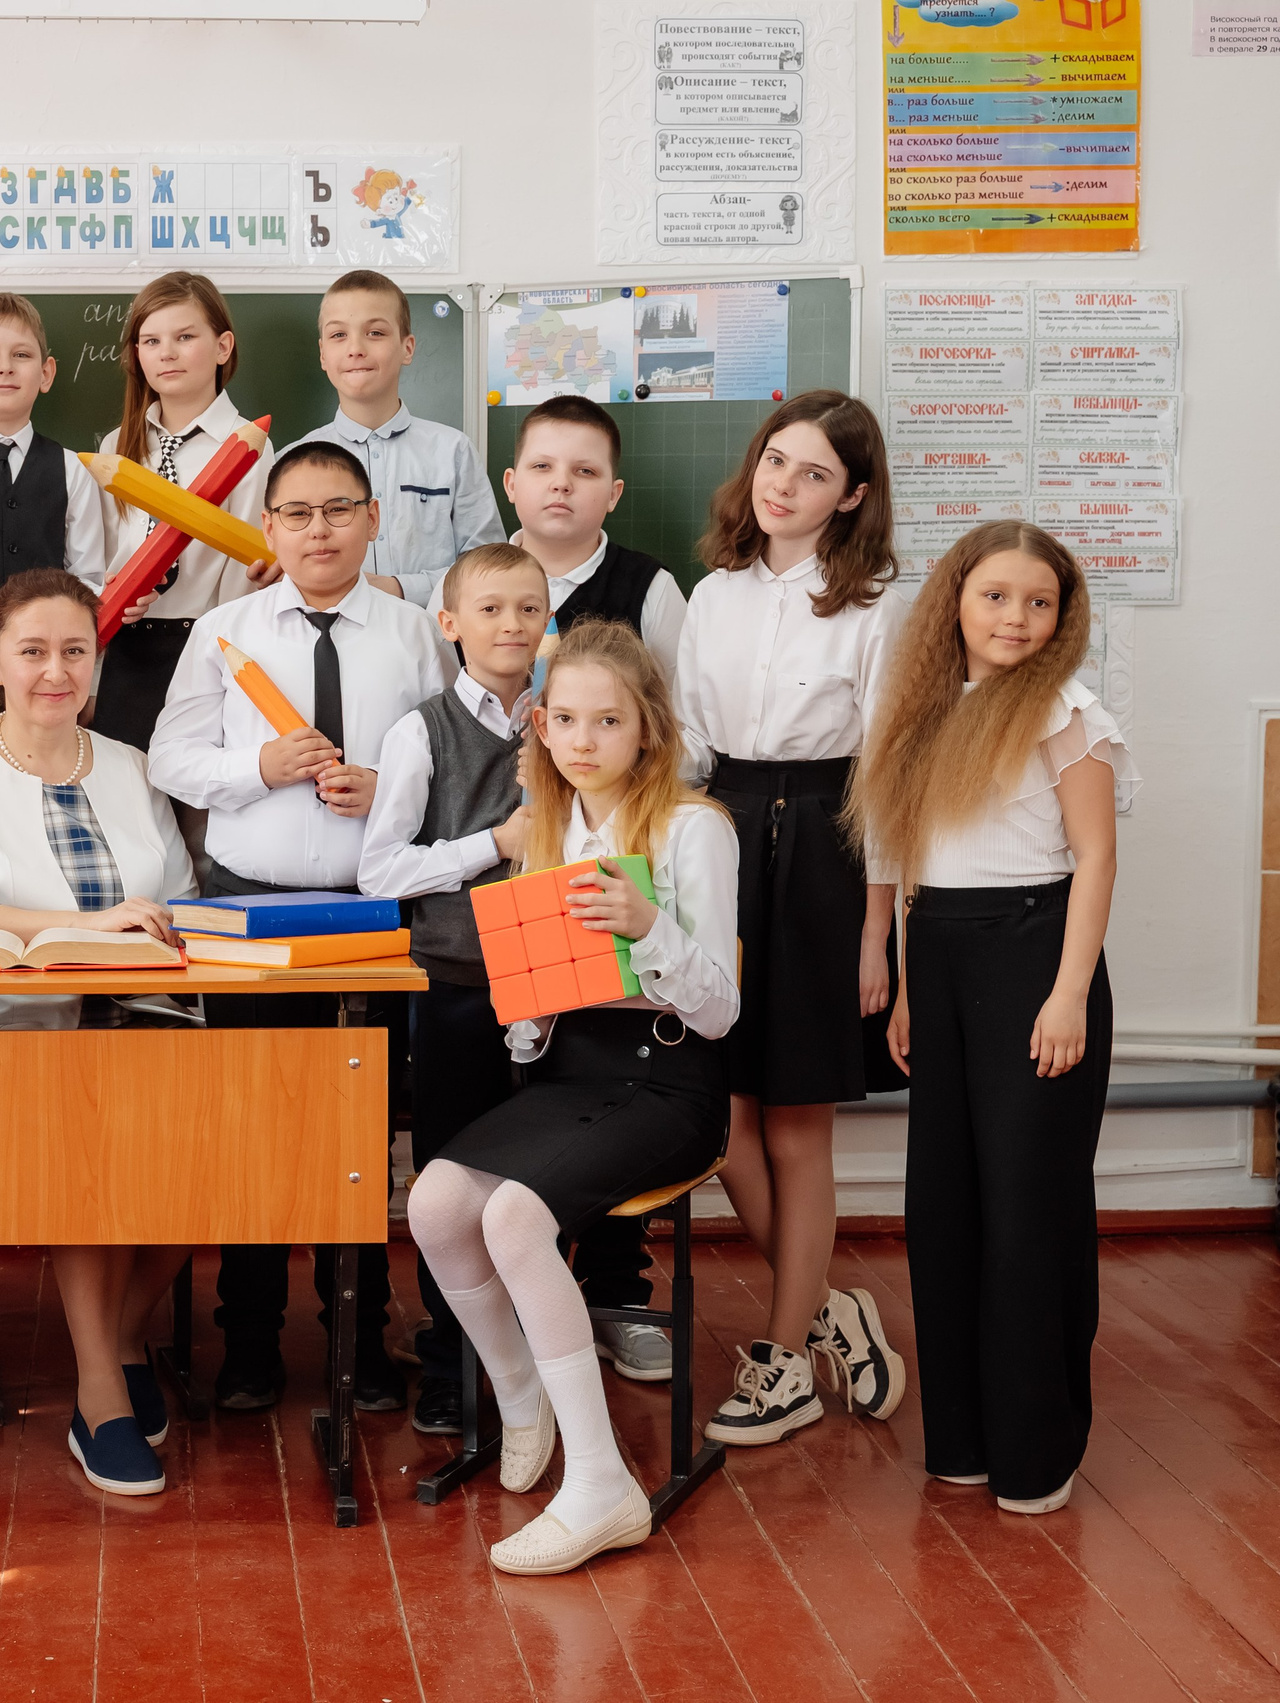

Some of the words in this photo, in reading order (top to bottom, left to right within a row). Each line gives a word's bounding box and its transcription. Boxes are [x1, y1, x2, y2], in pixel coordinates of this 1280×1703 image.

[1210, 15, 1261, 23] Високосный
[659, 23, 752, 35] Повествование
[765, 26, 801, 36] текст,
[673, 41, 712, 49] котором
[1217, 46, 1254, 54] феврале
[681, 52, 736, 62] происходят
[738, 52, 778, 61] события
[890, 57, 905, 65] на
[674, 76, 737, 87] Описание
[751, 78, 787, 88] текст,
[890, 76, 905, 84] на
[1061, 72, 1126, 82] вычитаем
[684, 94, 723, 102] котором
[907, 98, 928, 110] раз
[930, 95, 975, 106] больше
[680, 106, 718, 115] предмет
[908, 113, 929, 125] раз
[932, 112, 979, 122] меньше
[758, 136, 792, 145] текст
[889, 138, 904, 146] на
[906, 135, 953, 146] сколько
[956, 134, 1000, 145] больше
[674, 151, 713, 160] котором
[738, 150, 795, 159] объяснение,
[889, 154, 904, 163] на
[906, 152, 953, 162] сколько
[955, 151, 1003, 162] меньше
[659, 164, 723, 173] рассуждения,
[725, 164, 798, 172] доказательства
[889, 176, 903, 184] во
[906, 173, 952, 184] сколько
[956, 174, 976, 186] раз
[979, 171, 1023, 183] больше
[888, 193, 902, 201] во
[905, 190, 952, 201] сколько
[955, 191, 975, 203] раз
[978, 190, 1024, 200] меньше
[692, 212, 725, 220] текста,
[739, 209, 765, 218] одной
[889, 214, 935, 225] сколько
[938, 214, 971, 225] всего
[664, 222, 701, 232] красной
[704, 223, 736, 232] строки
[738, 223, 749, 231] до
[750, 221, 784, 232] другой,
[725, 236, 759, 245] автора.
[645, 283, 707, 293] овосибирская
